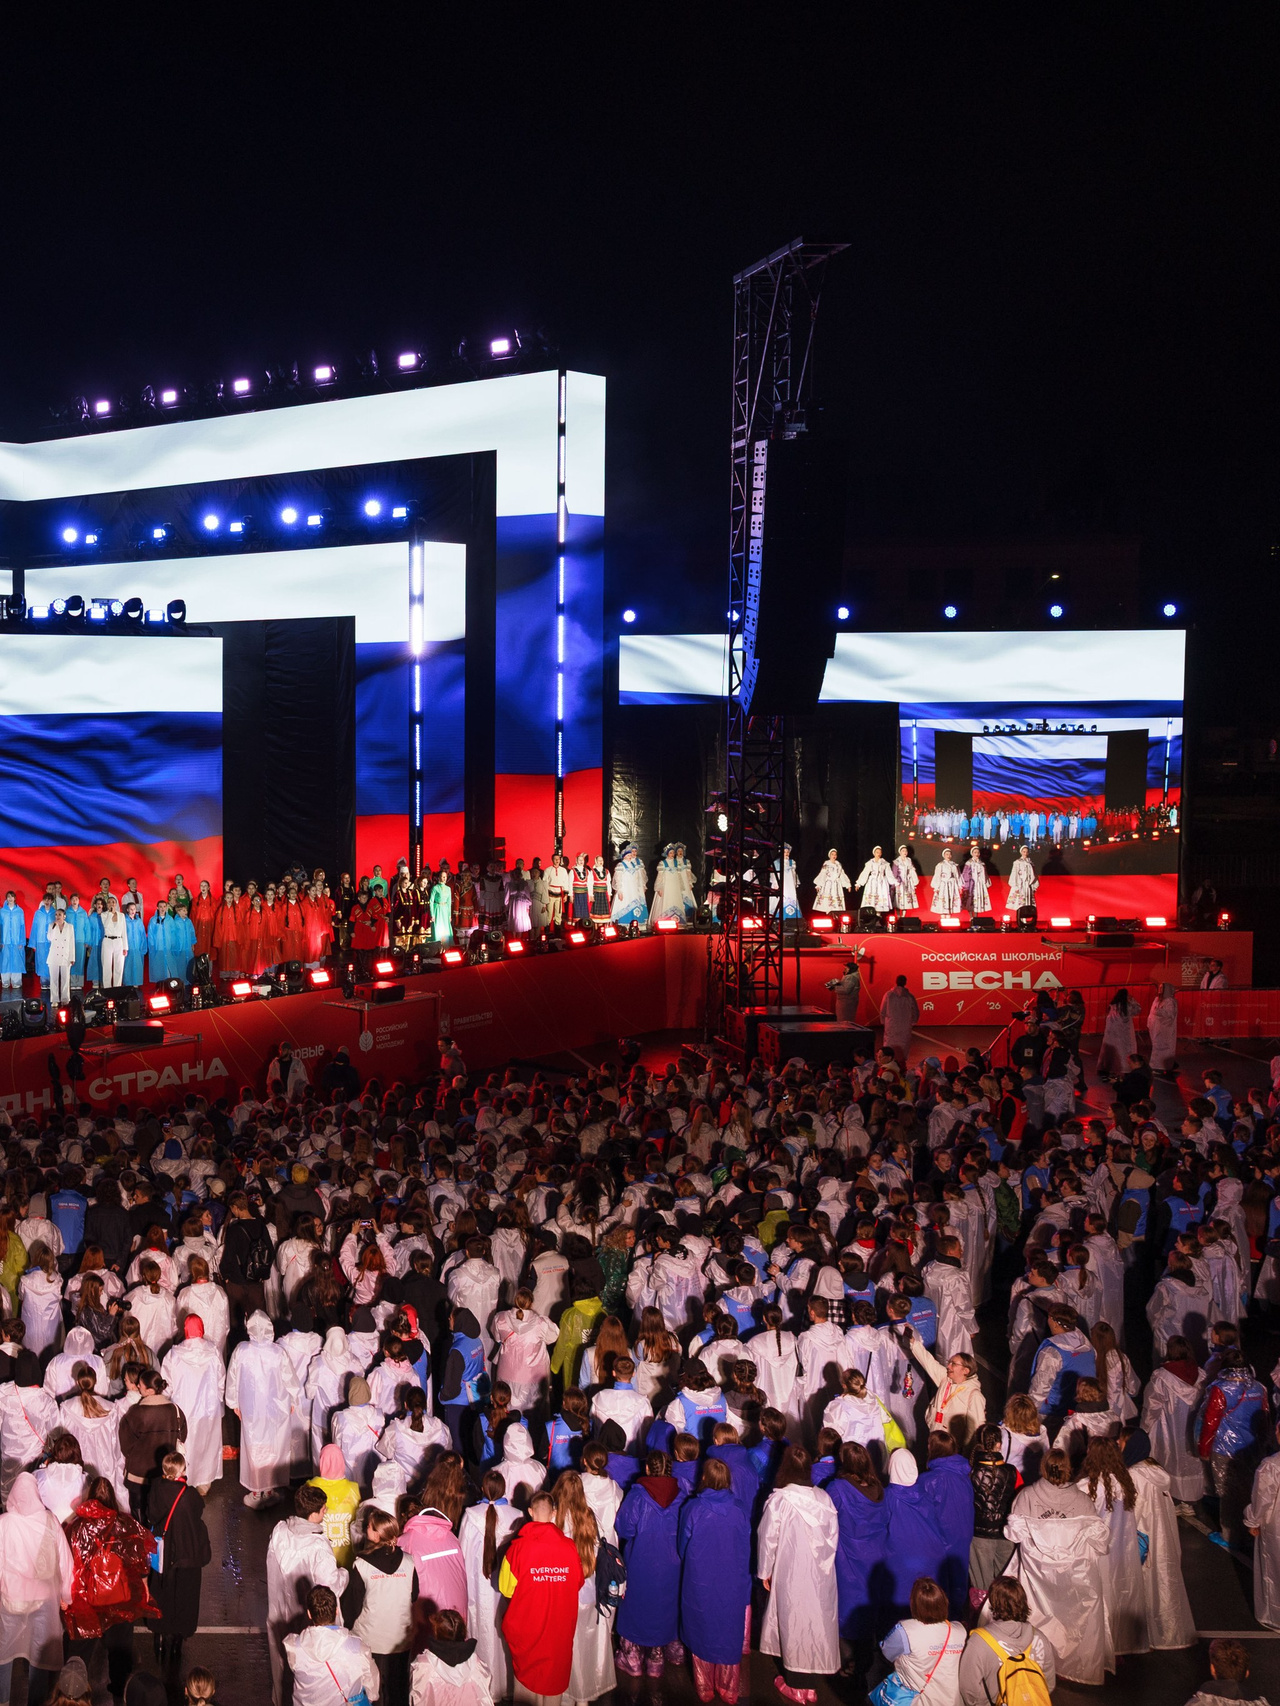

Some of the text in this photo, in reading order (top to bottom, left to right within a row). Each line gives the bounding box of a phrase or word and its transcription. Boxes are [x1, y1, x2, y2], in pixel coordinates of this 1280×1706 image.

[922, 952, 1062, 962] РОССИЙСКАЯ ШКОЛЬНАЯ
[922, 970, 1064, 990] ВЕСНА
[376, 1021, 408, 1034] РОССИЙСКИЙ
[376, 1034, 390, 1042] СОЮЗ
[88, 1057, 229, 1100] СТРАНА
[530, 1566, 570, 1575] EVERYONE
